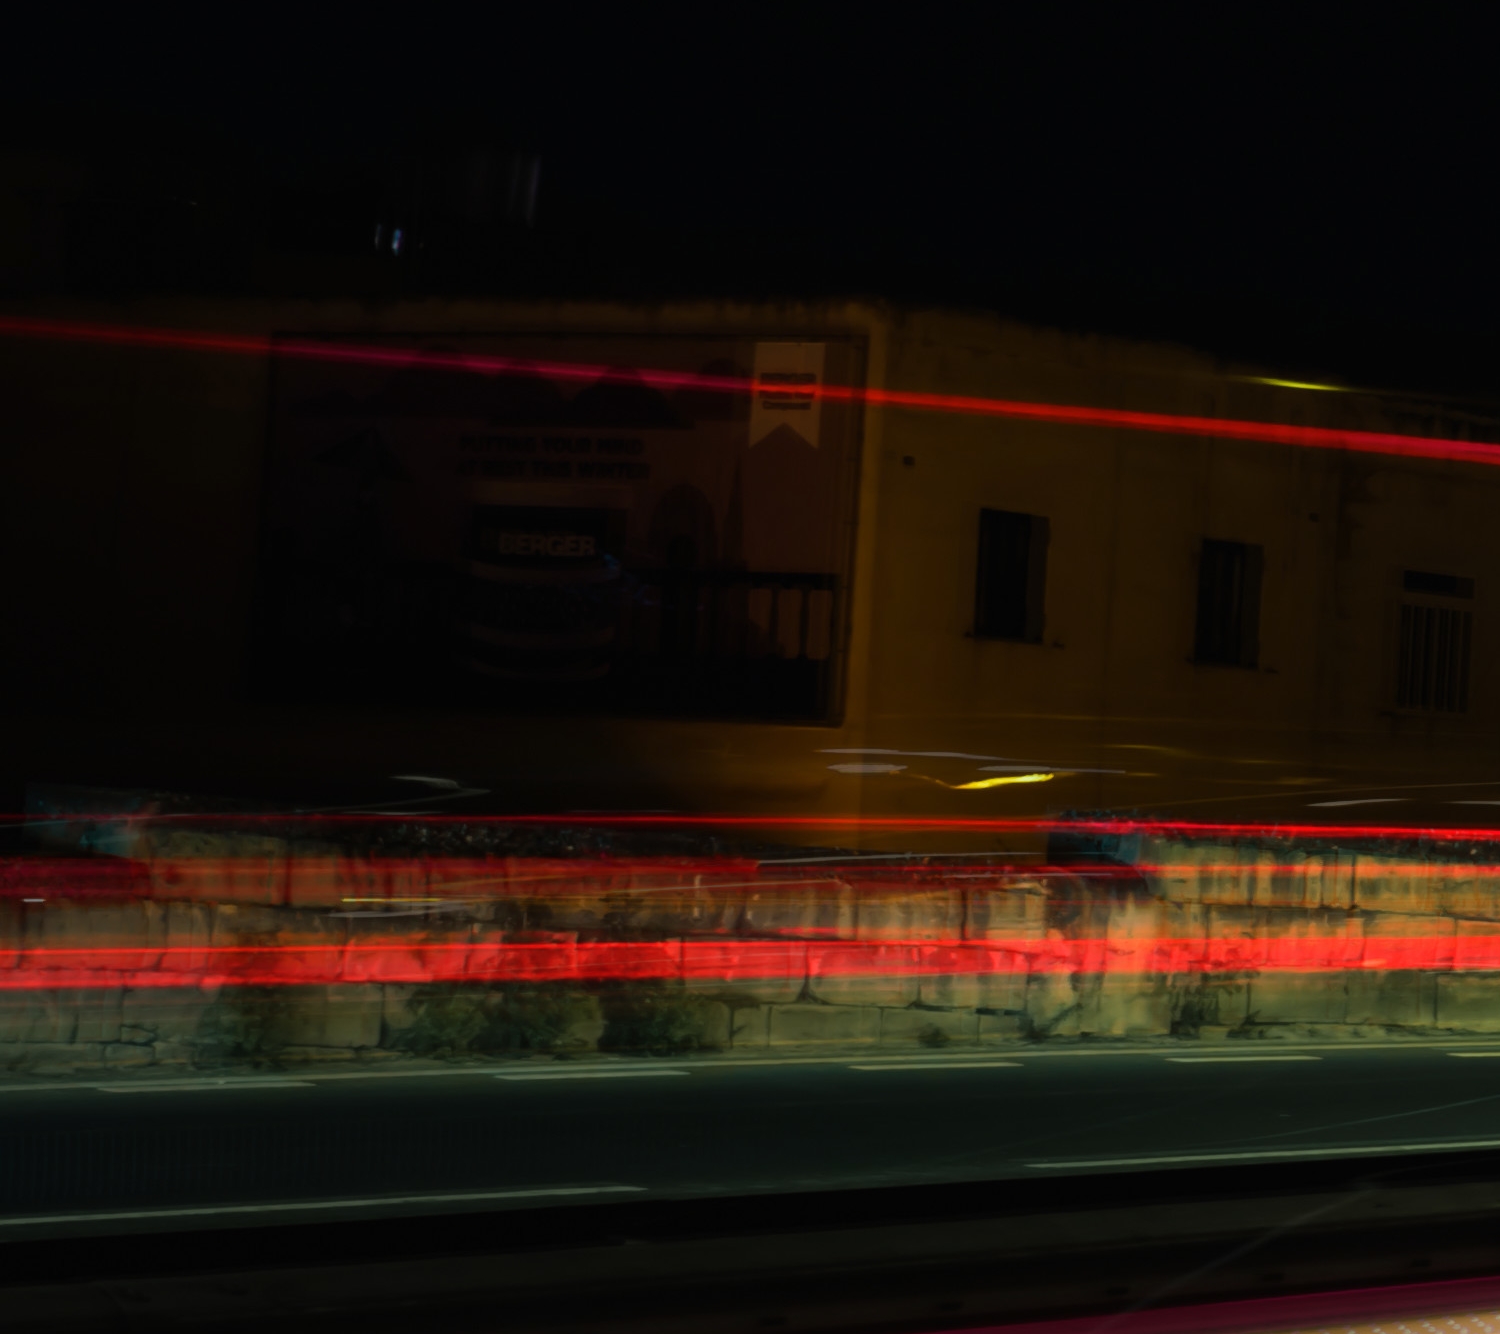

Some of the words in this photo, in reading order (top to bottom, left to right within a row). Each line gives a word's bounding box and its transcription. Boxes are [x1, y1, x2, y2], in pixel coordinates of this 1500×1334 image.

[458, 435, 536, 454] PUTTING
[541, 436, 592, 455] YOUR
[455, 459, 479, 477] AT
[481, 460, 527, 477] REST
[532, 461, 573, 478] THIS
[577, 461, 652, 480] WINTER
[497, 531, 597, 557] BERGER
